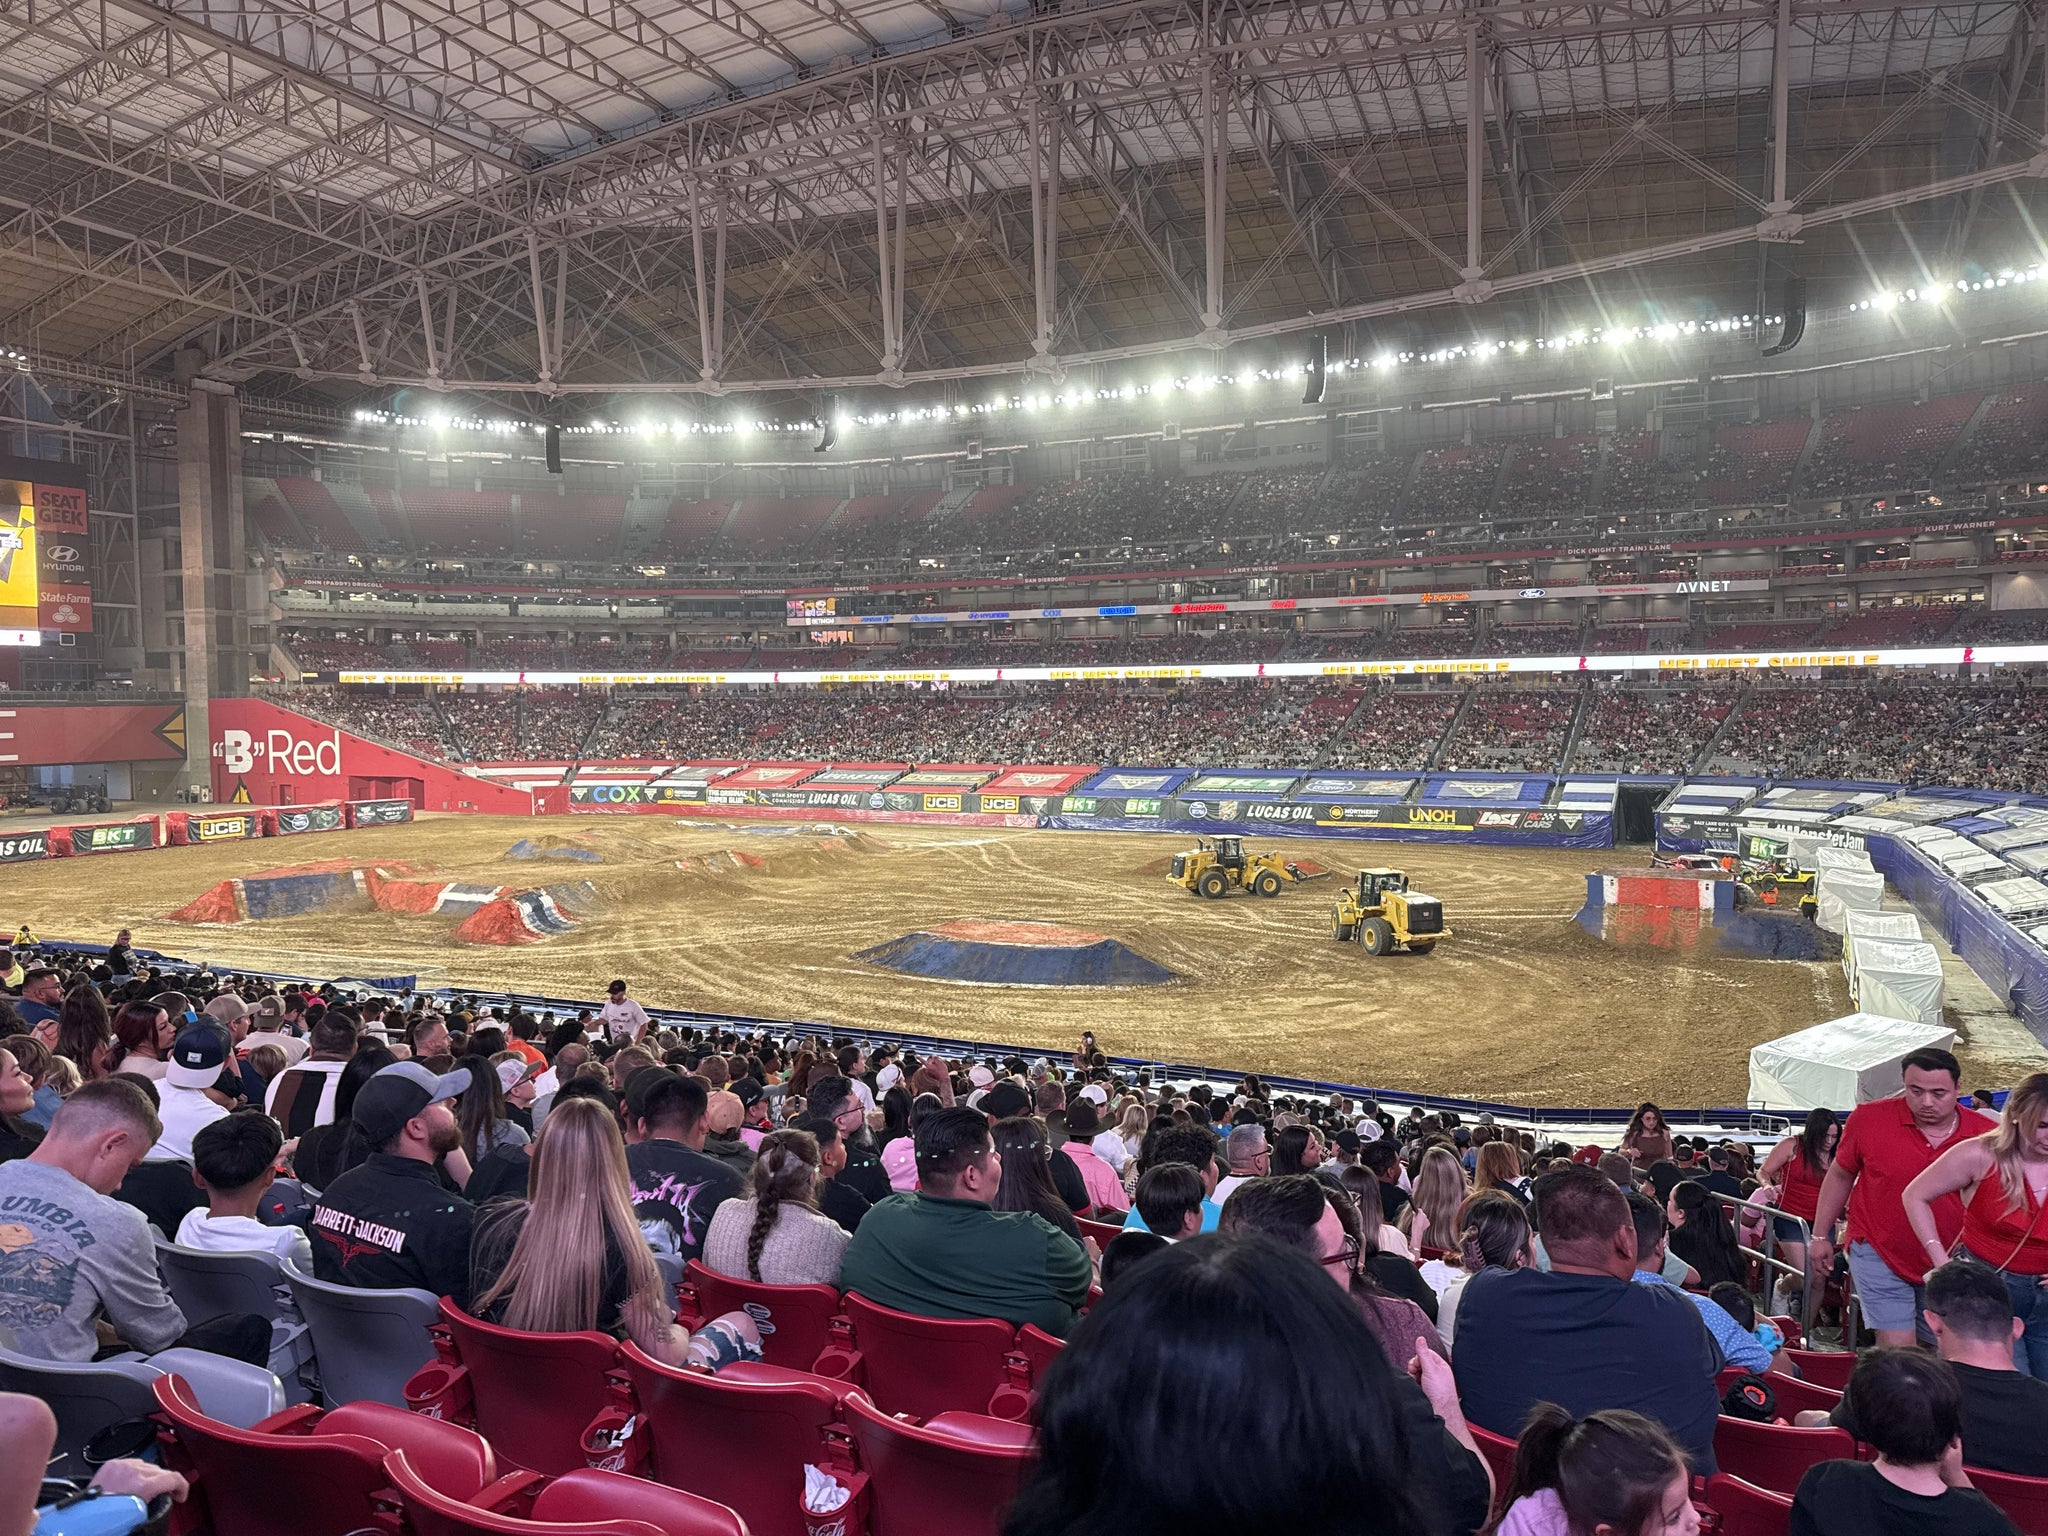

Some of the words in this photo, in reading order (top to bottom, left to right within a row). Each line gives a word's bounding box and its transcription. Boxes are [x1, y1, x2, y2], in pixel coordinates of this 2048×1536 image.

[40, 492, 81, 509] SEAT
[39, 508, 83, 526] GEEK
[1925, 524, 1950, 532] KURT
[1953, 521, 1996, 530] WARNER
[43, 562, 84, 572] HYUNDAI
[1676, 580, 1730, 593] AVNET
[1042, 609, 1061, 617] COX
[593, 786, 640, 803] COX
[808, 793, 839, 805] LUCAS
[927, 796, 958, 808] JCB
[984, 797, 1016, 809] JCB
[1064, 799, 1096, 812] BKT
[1127, 800, 1160, 813] BKT
[1247, 805, 1290, 818] LUCAS
[1409, 807, 1456, 822] UNOH
[205, 821, 241, 835] JCB
[1524, 820, 1552, 828] CARS
[93, 829, 135, 843] BKT
[1751, 841, 1777, 855] BKT
